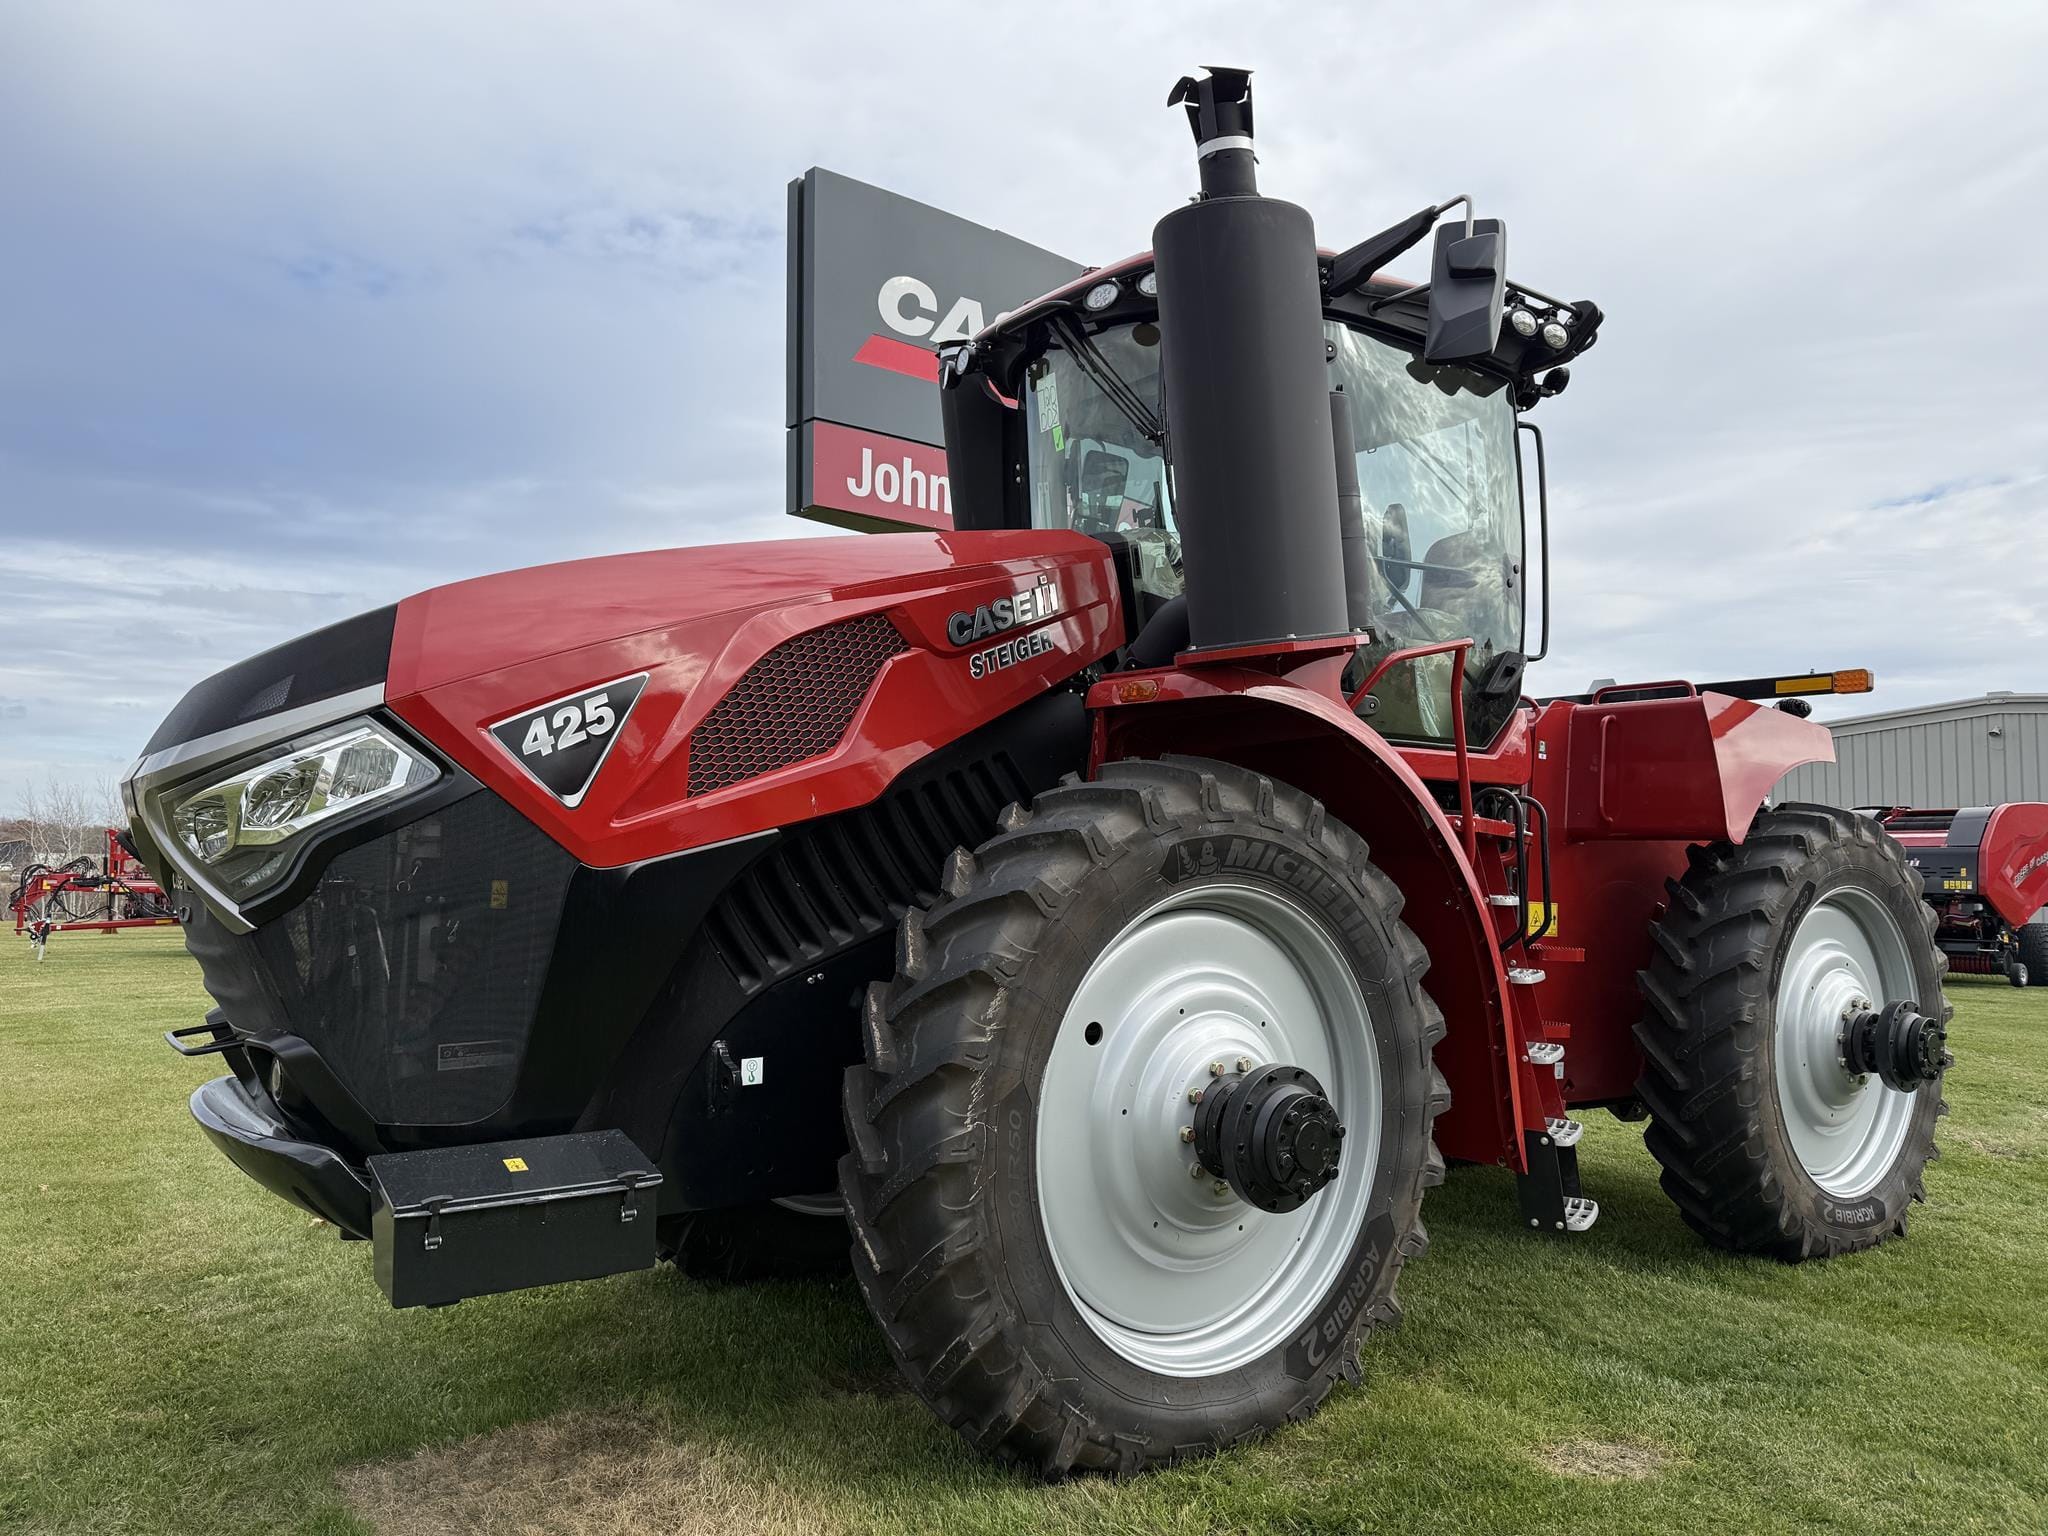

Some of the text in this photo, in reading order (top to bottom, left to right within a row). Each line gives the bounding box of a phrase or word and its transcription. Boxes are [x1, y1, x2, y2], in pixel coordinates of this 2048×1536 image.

[878, 275, 1010, 344] CA
[969, 629, 1054, 680] STEIGER
[522, 692, 616, 757] 425
[1823, 1199, 1876, 1225] AGRIBIB 2
[1300, 1239, 1381, 1367] AGRIBIB 2
